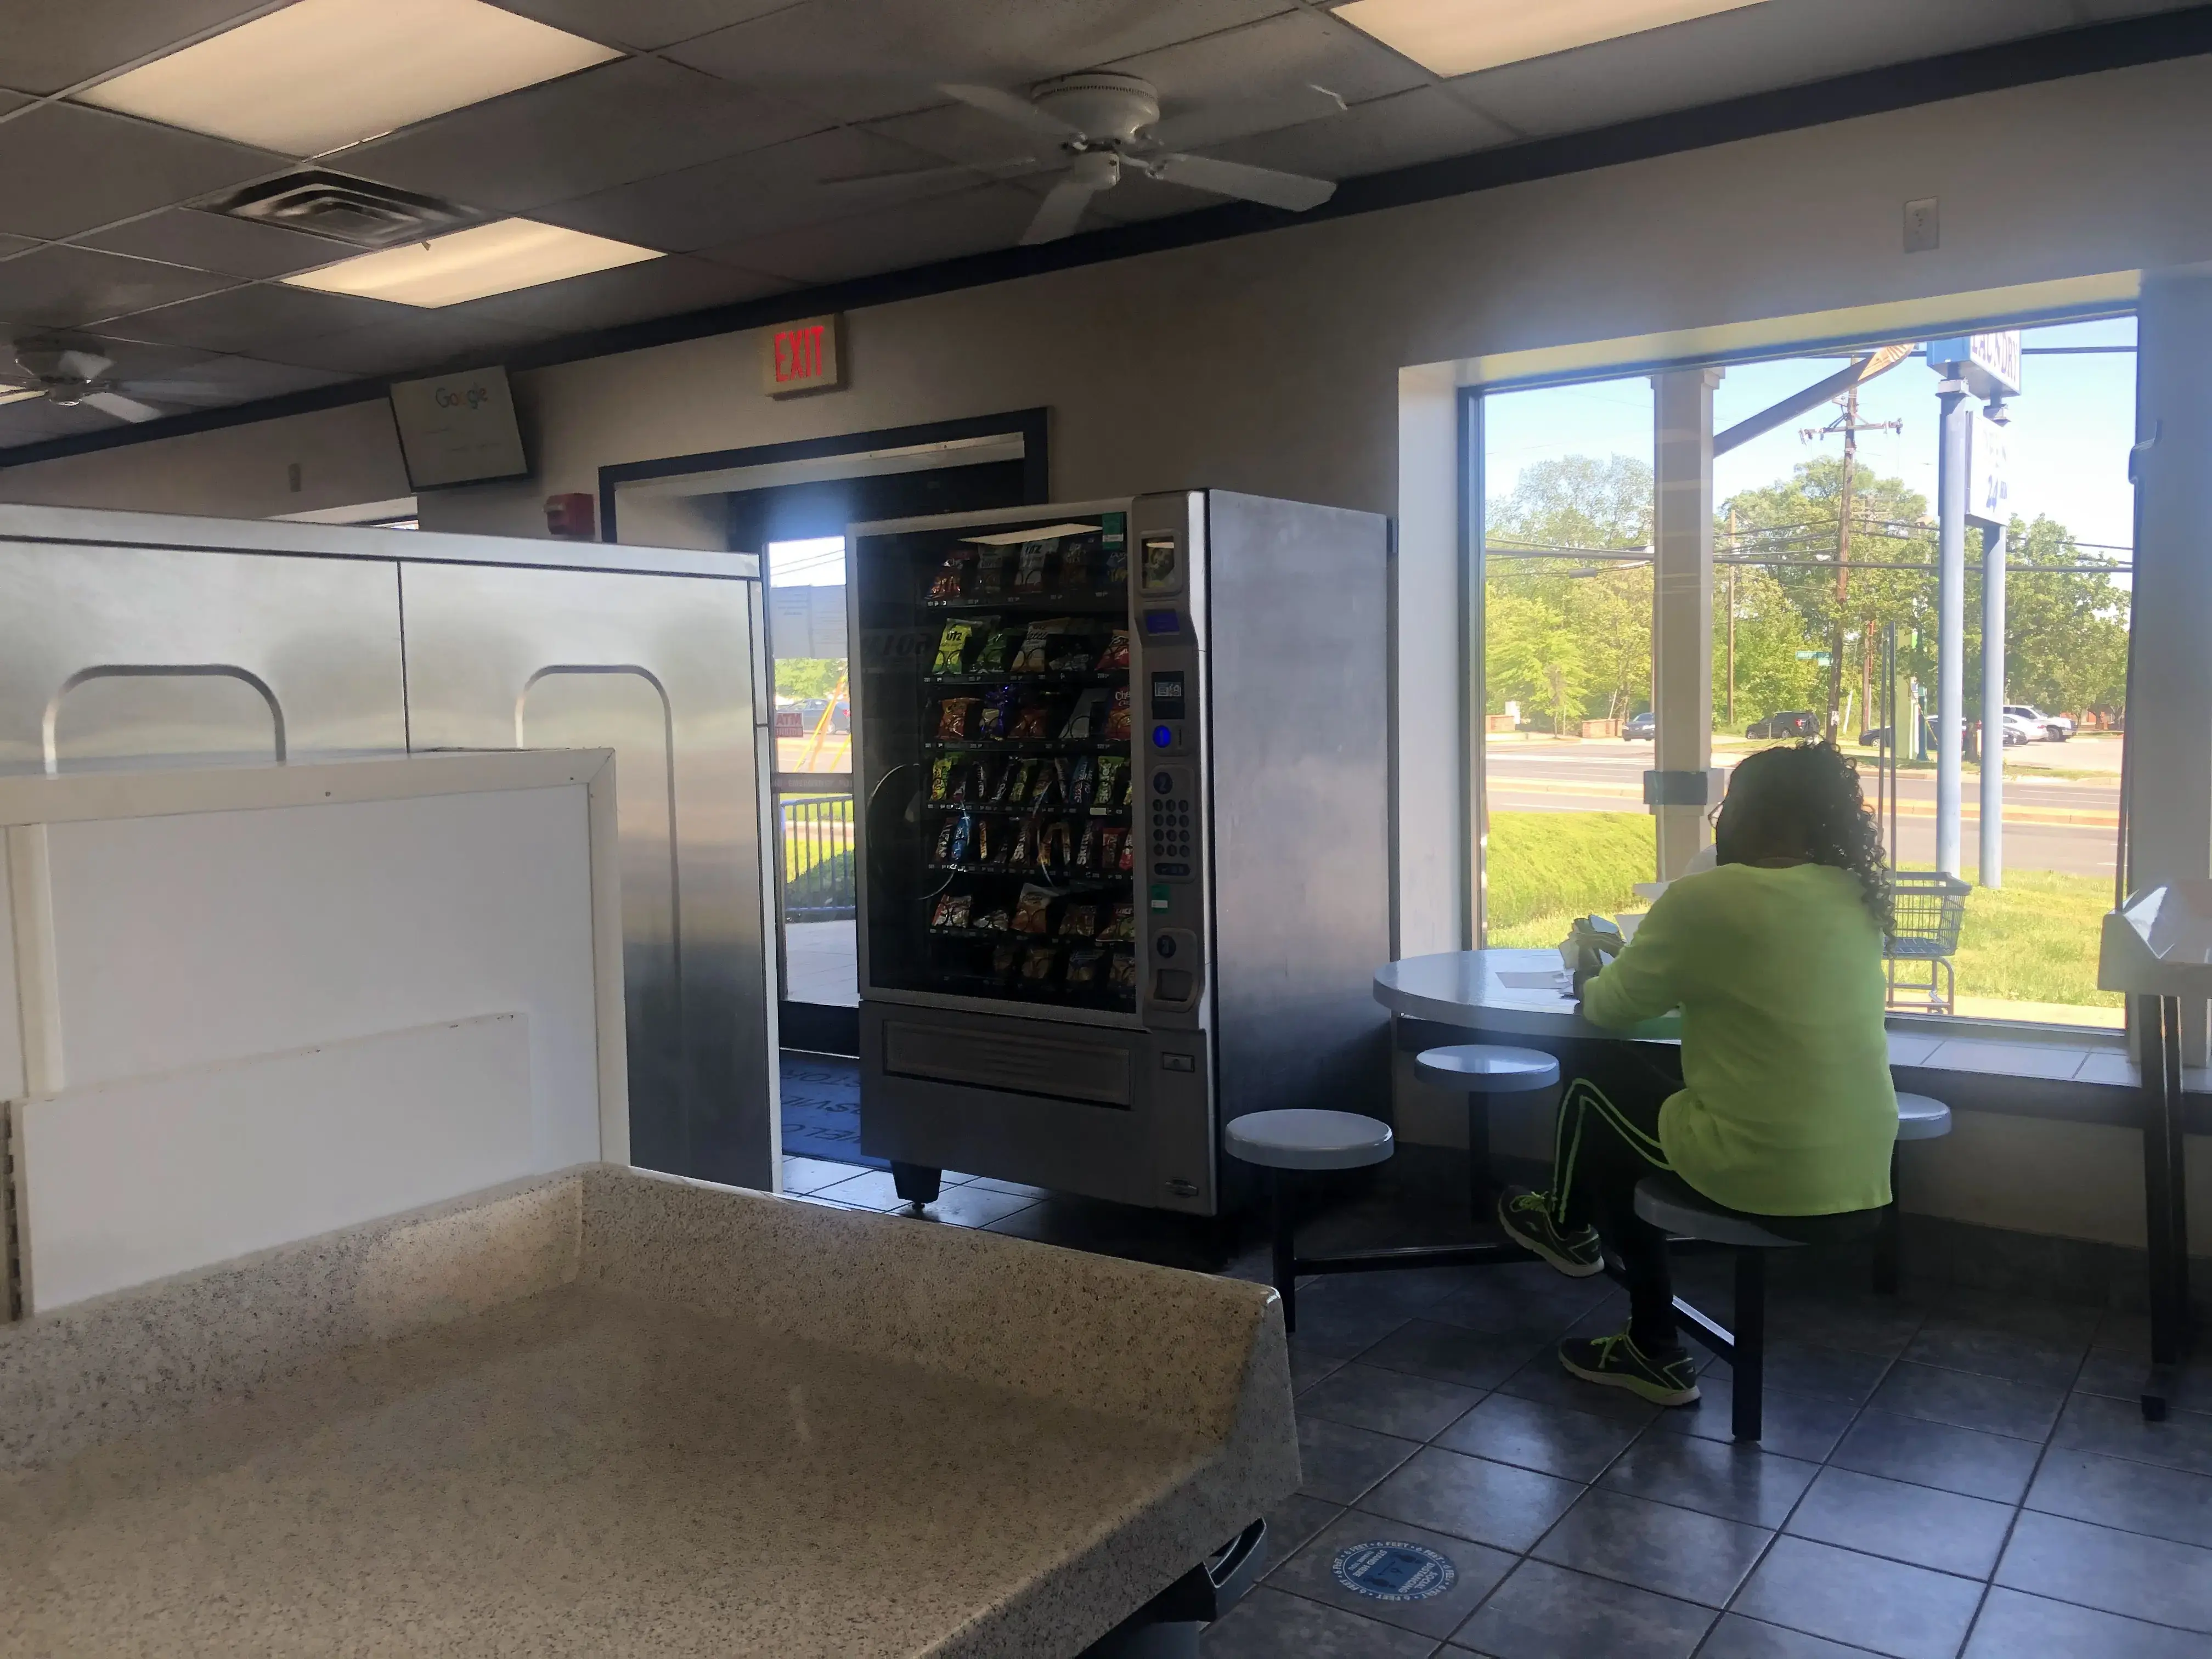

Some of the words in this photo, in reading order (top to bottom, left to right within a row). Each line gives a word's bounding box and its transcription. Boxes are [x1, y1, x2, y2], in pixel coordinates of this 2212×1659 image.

[774, 325, 824, 382] EXIT
[435, 381, 488, 410] Google
[776, 713, 801, 725] ATM
[1350, 1543, 1369, 1552] FEET
[1367, 1549, 1387, 1565] STAND
[1352, 1564, 1371, 1577] HERE
[1398, 1562, 1435, 1594] DISTANCING
[1414, 1571, 1438, 1589] SOCIAL
